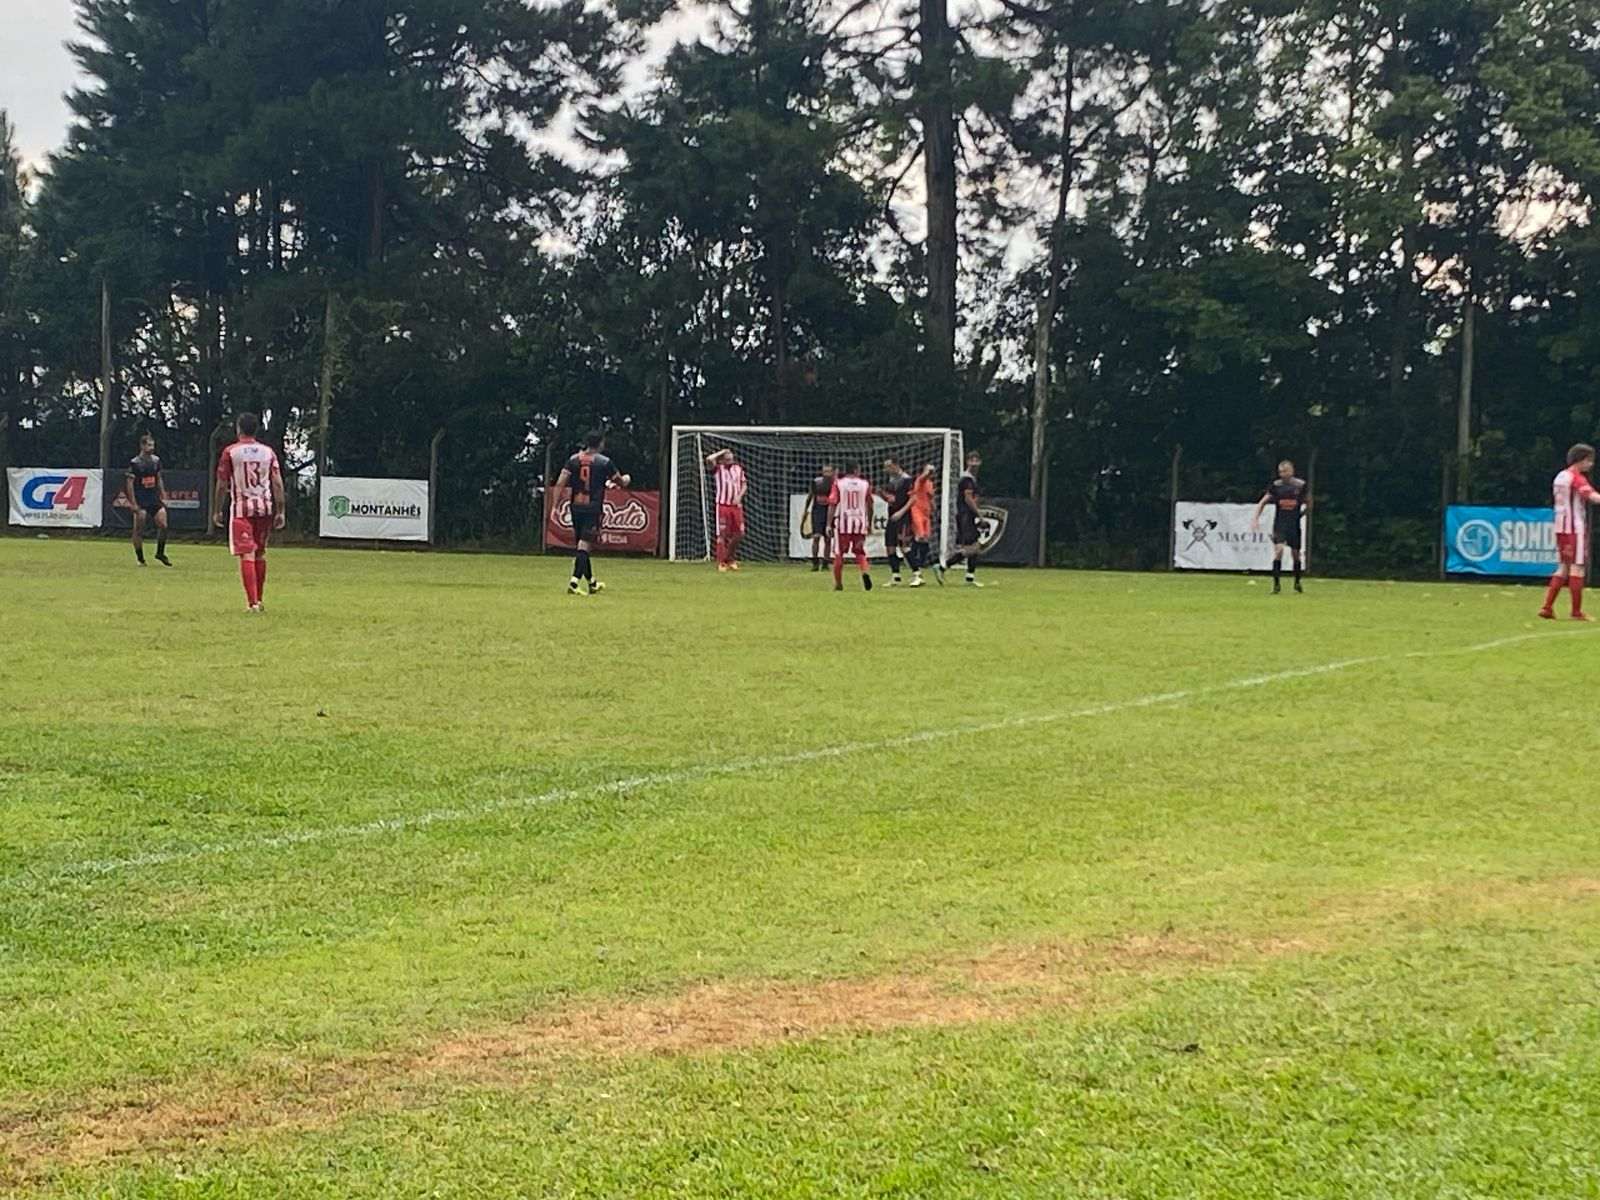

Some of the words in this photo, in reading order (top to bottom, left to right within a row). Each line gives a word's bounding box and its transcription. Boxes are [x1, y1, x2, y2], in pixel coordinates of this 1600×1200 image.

[243, 461, 262, 489] 13
[22, 476, 88, 510] G4
[847, 490, 859, 510] 10
